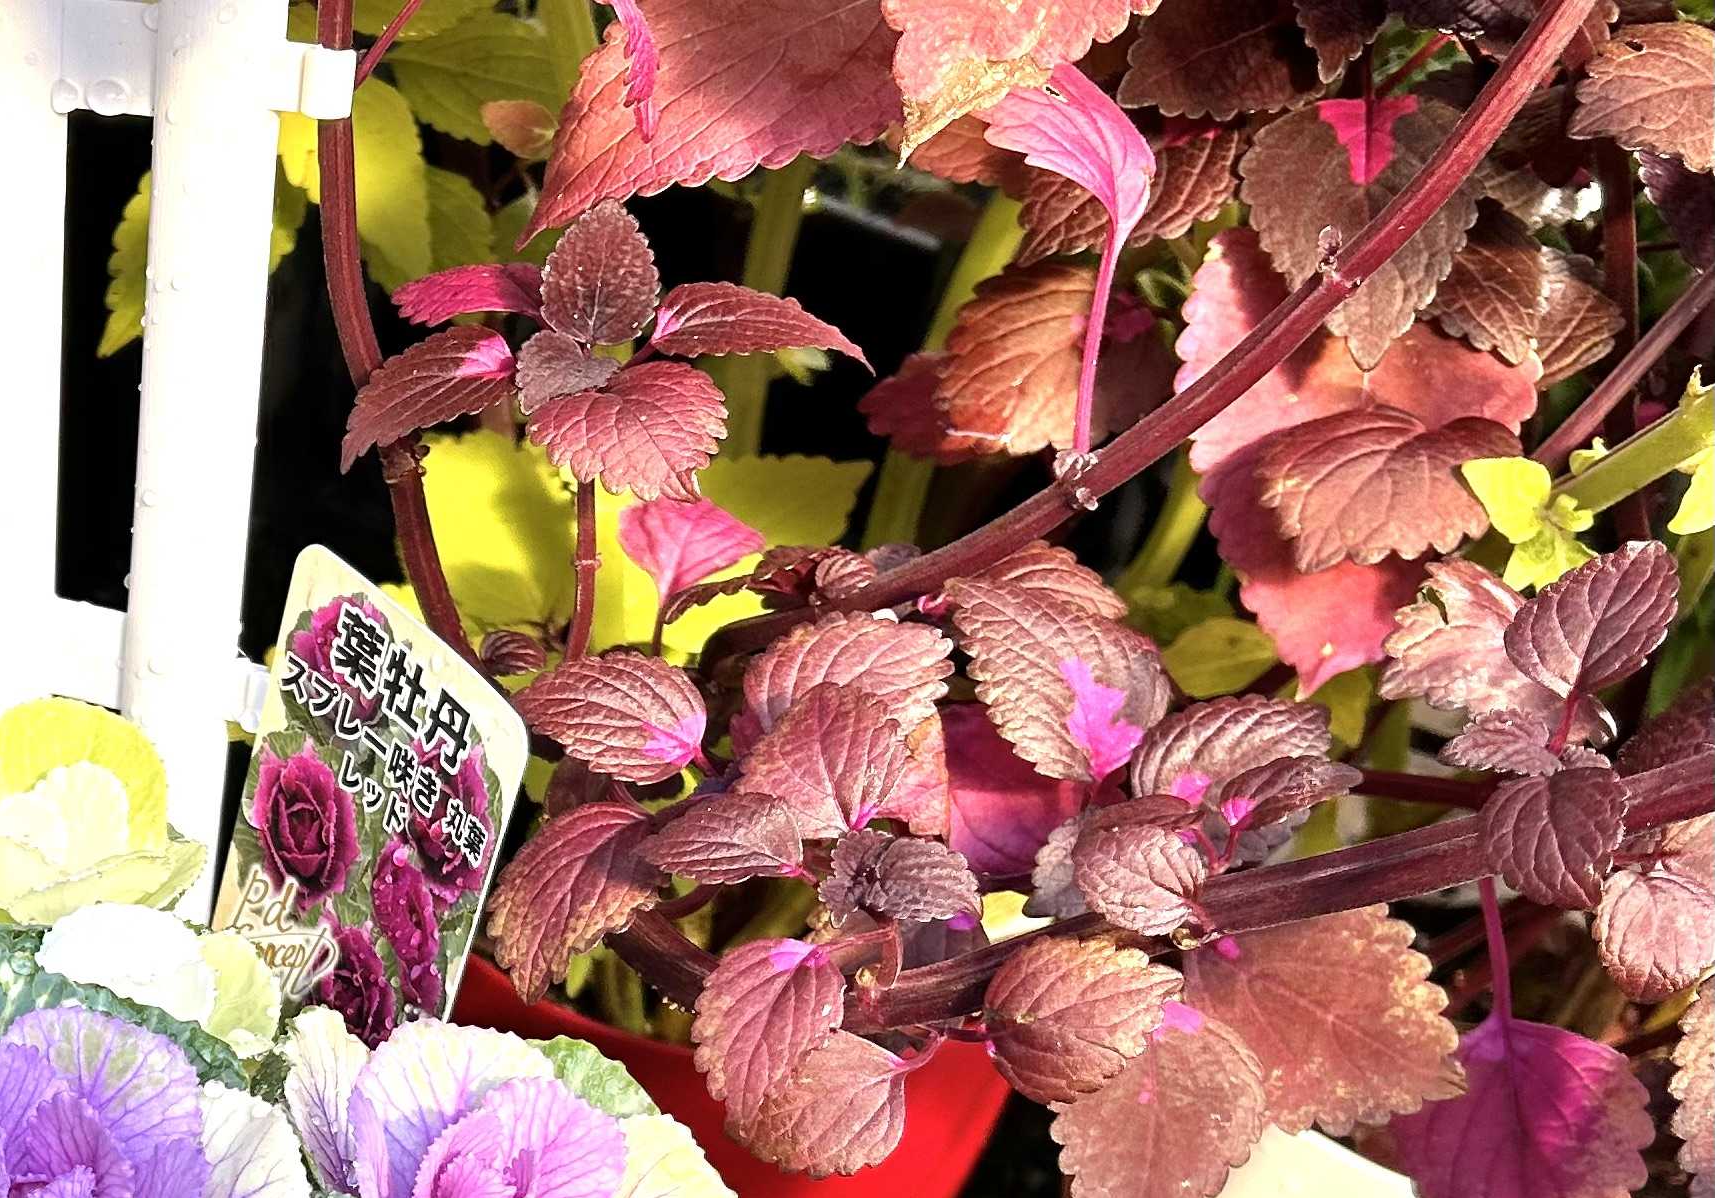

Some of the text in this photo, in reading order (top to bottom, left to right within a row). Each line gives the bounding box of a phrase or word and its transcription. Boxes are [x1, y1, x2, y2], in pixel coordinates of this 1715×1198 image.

[281, 654, 486, 864] スプレー咲き 丸葉
[333, 607, 471, 769] 葉牡丹
[340, 754, 407, 830] レッド
